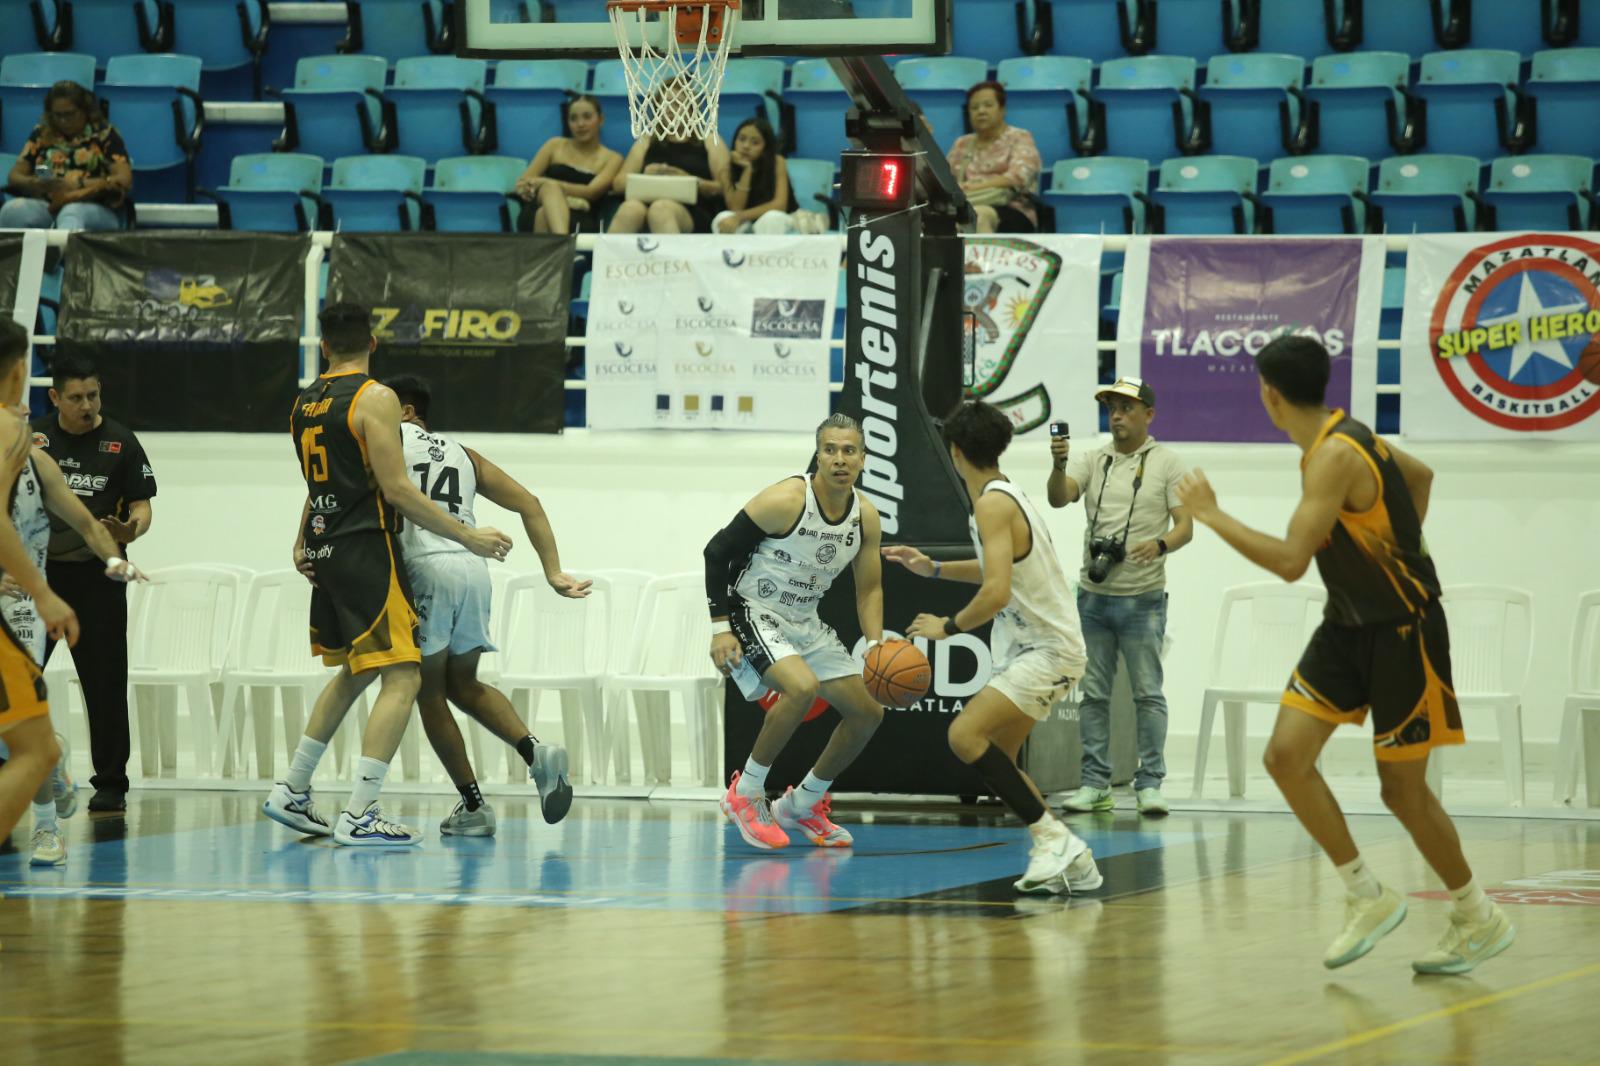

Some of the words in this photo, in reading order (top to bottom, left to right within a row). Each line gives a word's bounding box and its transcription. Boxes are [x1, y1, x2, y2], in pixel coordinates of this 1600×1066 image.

[882, 162, 898, 196] 7
[605, 259, 693, 279] ESCOCESA
[675, 317, 738, 330] ESCOCESA
[754, 317, 820, 332] ESCOCESA
[1437, 320, 1522, 359] SUPER
[595, 361, 658, 376] ESCOCESA
[1472, 384, 1591, 415] BASKETBALL
[413, 462, 463, 514] 14
[845, 532, 855, 547] 5
